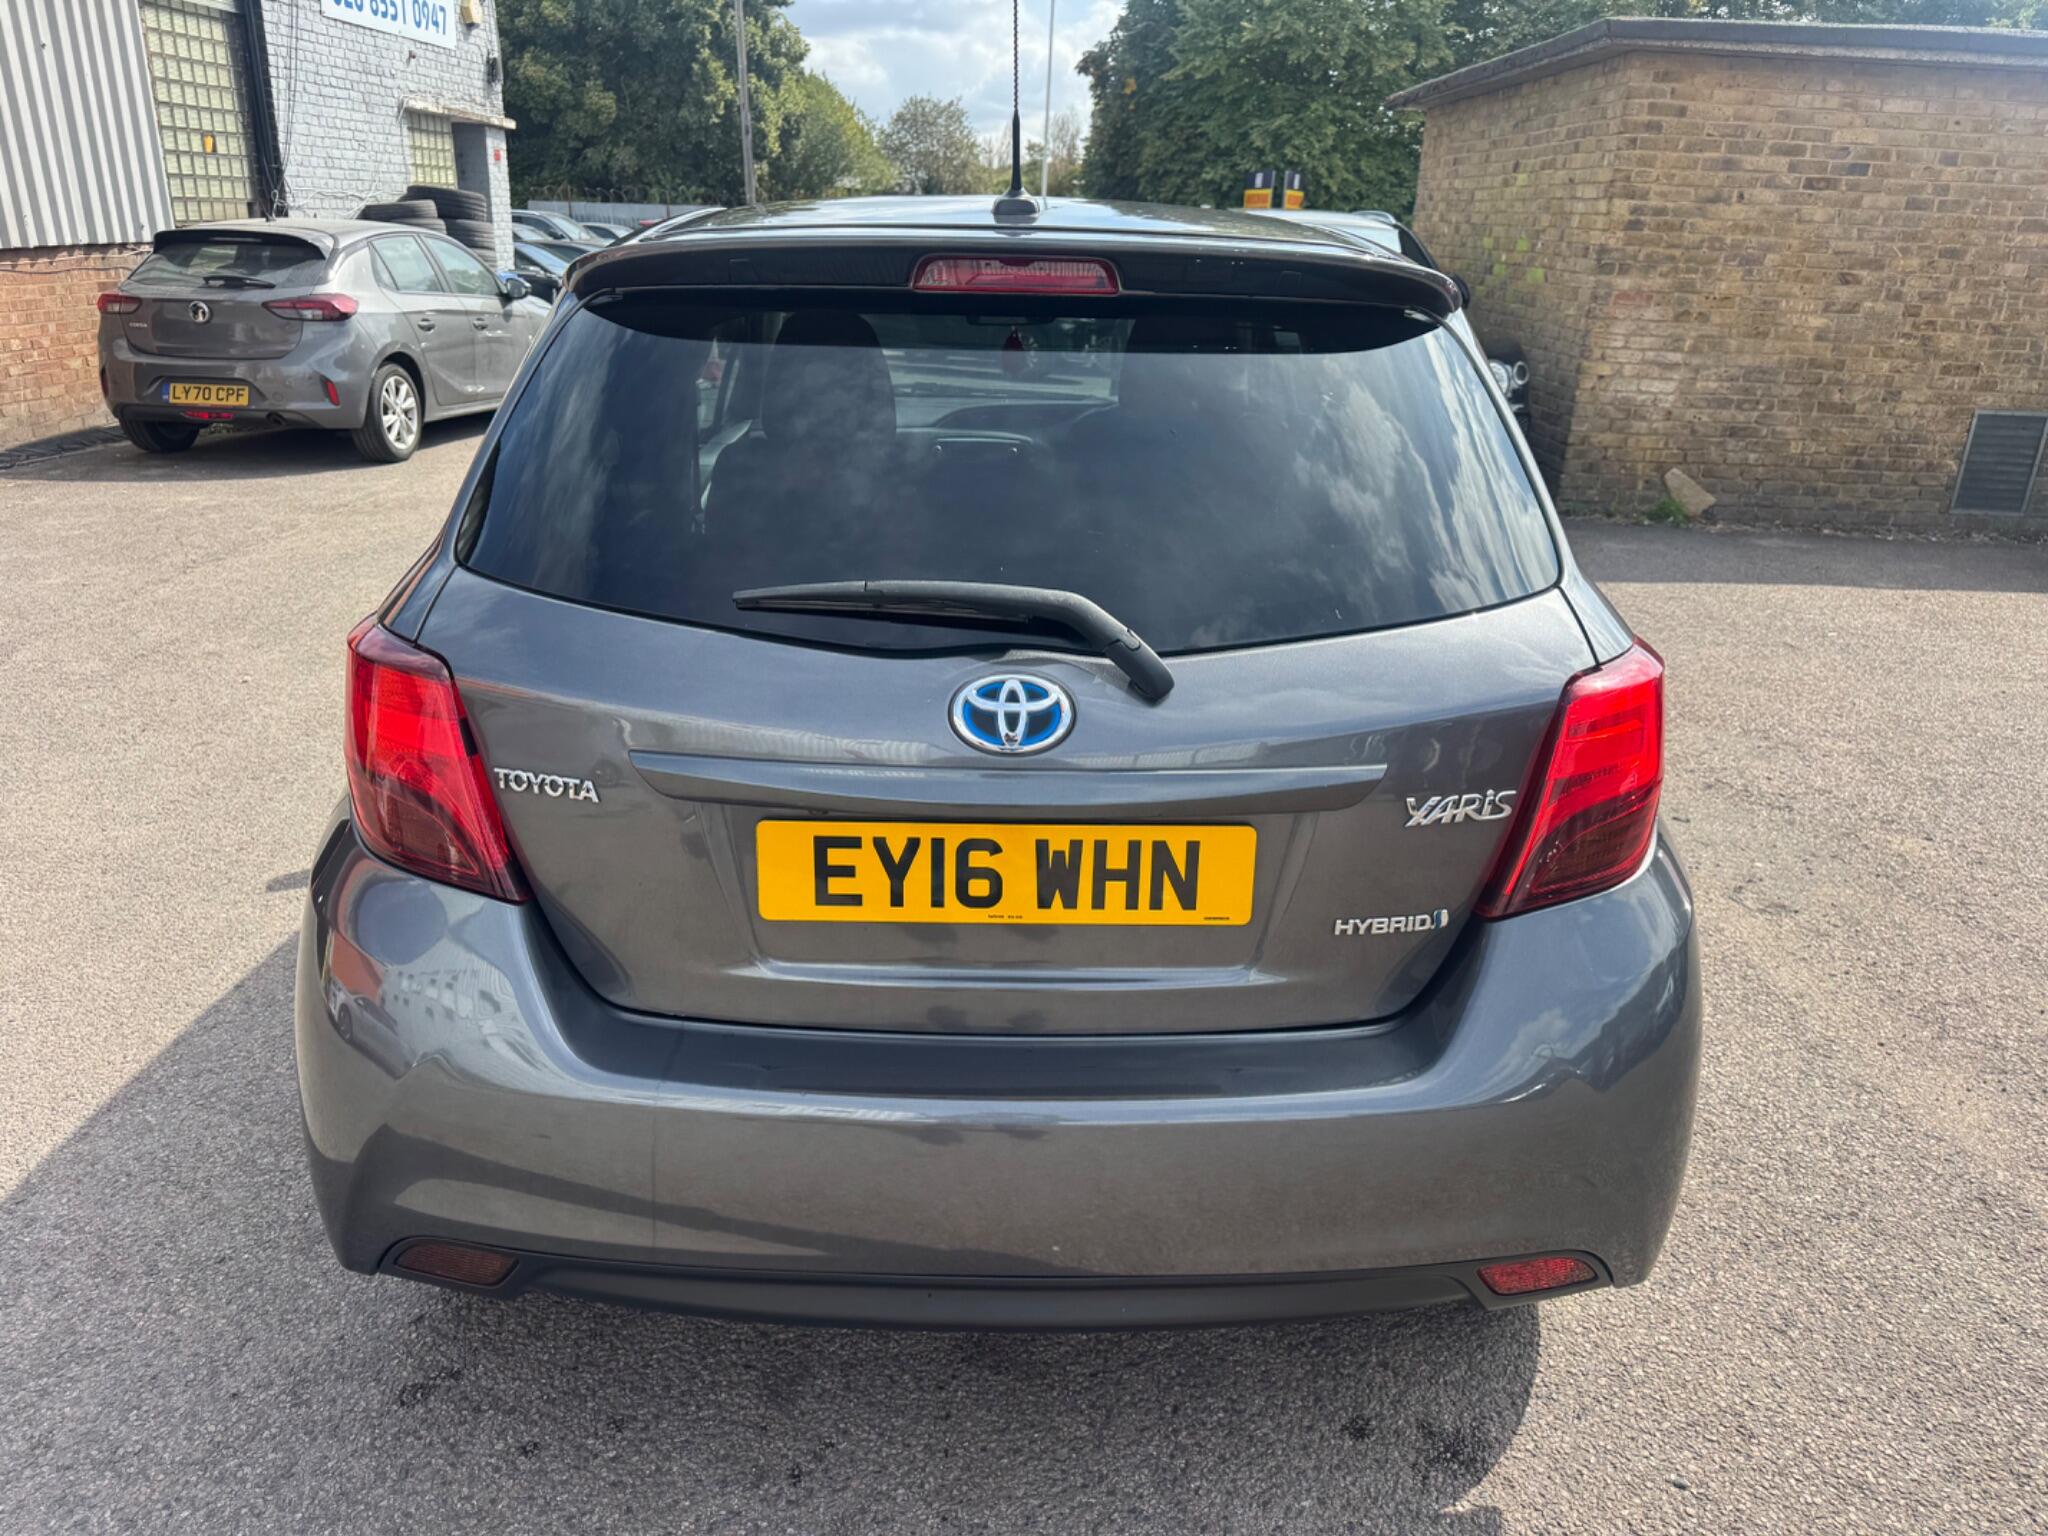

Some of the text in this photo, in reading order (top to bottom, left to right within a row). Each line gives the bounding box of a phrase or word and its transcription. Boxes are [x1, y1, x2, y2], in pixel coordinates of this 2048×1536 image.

[413, 0, 446, 35] 0947
[172, 385, 245, 402] LY70 CPF
[494, 767, 599, 803] TOYOTA
[813, 835, 1200, 911] EY16 WHN
[1334, 914, 1432, 936] HYBRID
